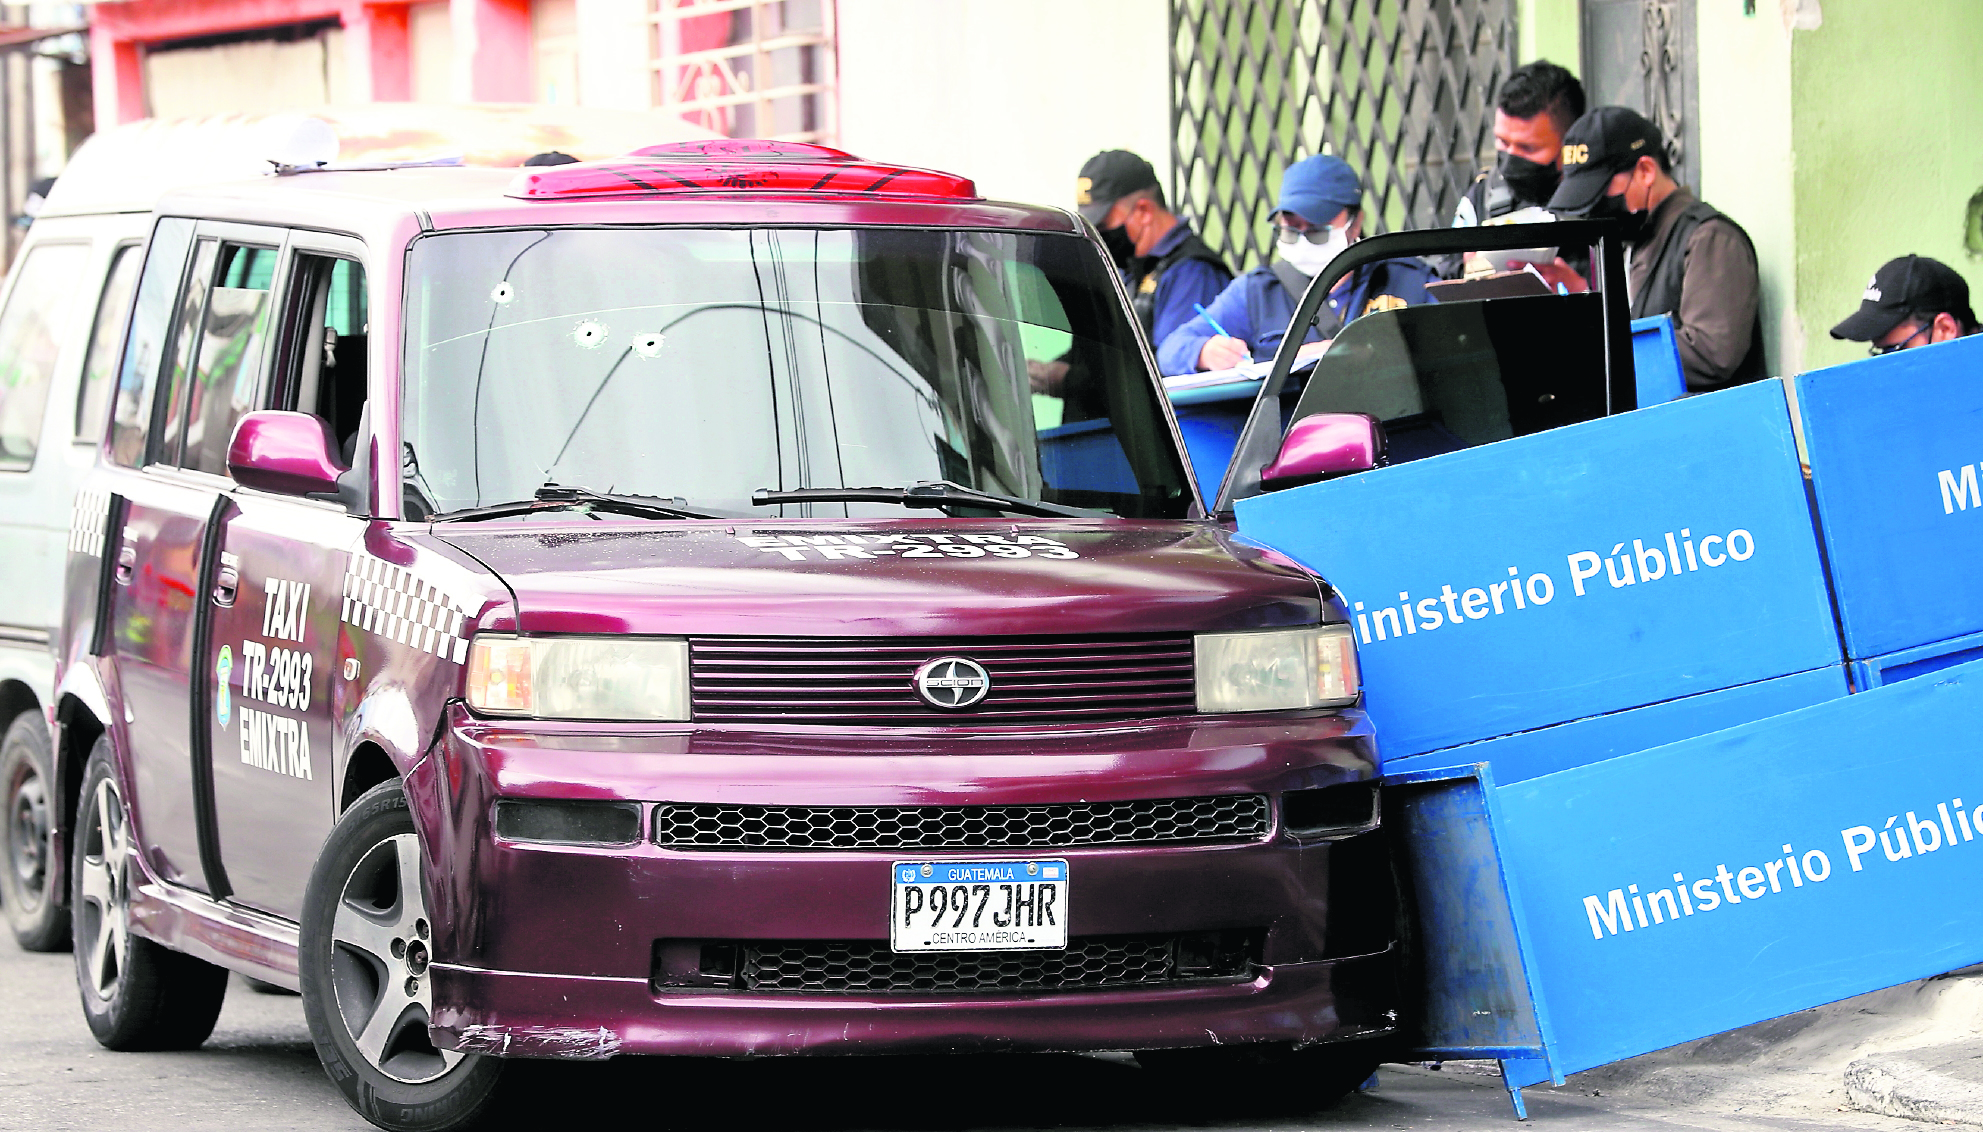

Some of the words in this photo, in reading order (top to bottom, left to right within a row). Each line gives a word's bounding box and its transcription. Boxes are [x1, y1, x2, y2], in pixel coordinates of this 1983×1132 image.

[735, 534, 1070, 547] EMIXTRA
[759, 544, 1080, 561] TR-2993
[262, 577, 310, 642] TAXI
[1353, 566, 1555, 651] inisterio
[1567, 527, 1756, 597] Público
[242, 640, 313, 711] TR-2993
[239, 706, 313, 780] EMIXTRA
[905, 884, 1057, 928] P997JHR
[948, 868, 1015, 881] GUATEMALA
[1582, 843, 1831, 940] Ministerio
